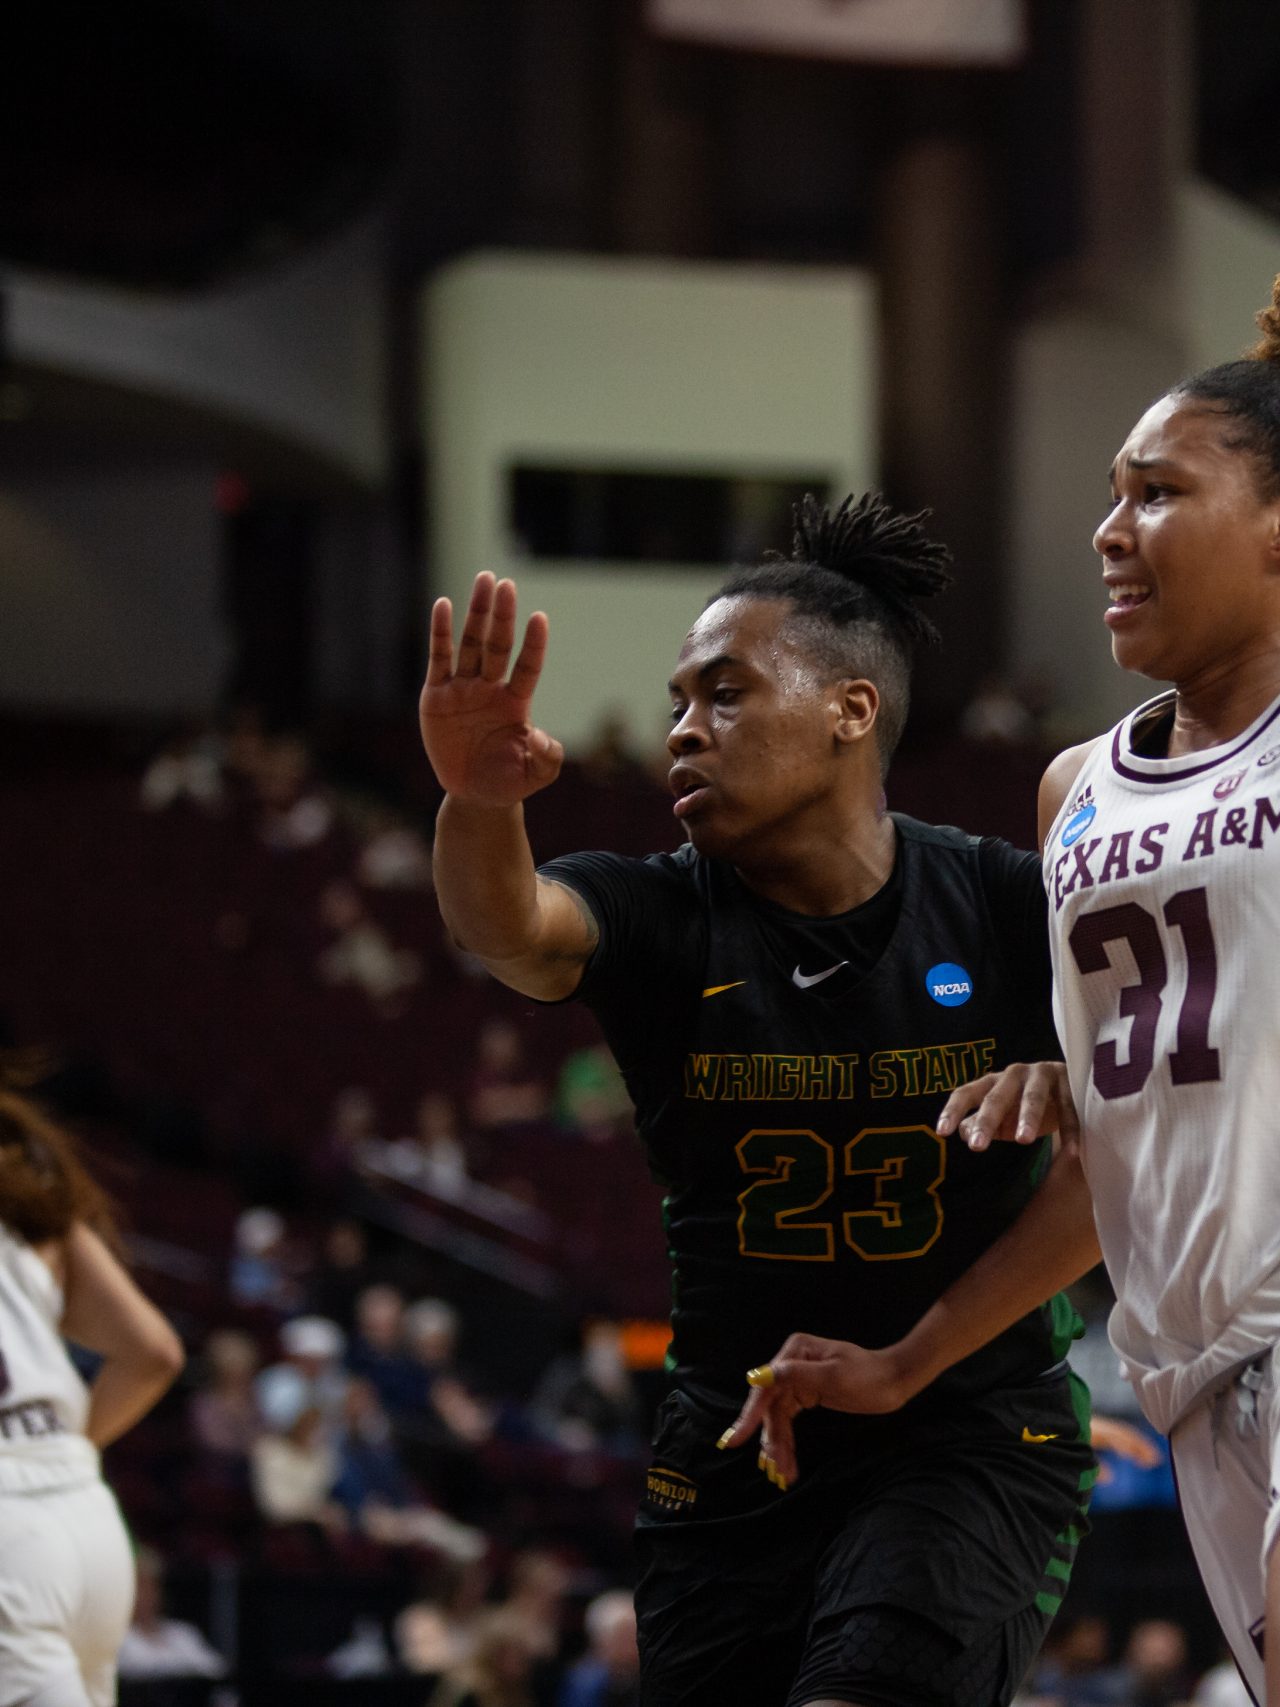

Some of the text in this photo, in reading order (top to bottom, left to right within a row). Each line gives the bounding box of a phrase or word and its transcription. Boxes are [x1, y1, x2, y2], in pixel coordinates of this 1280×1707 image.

[933, 982, 971, 997] NCAA
[1069, 887, 1221, 1100] 31
[684, 1038, 997, 1101] WRIGHT STATE
[734, 1124, 947, 1262] 23
